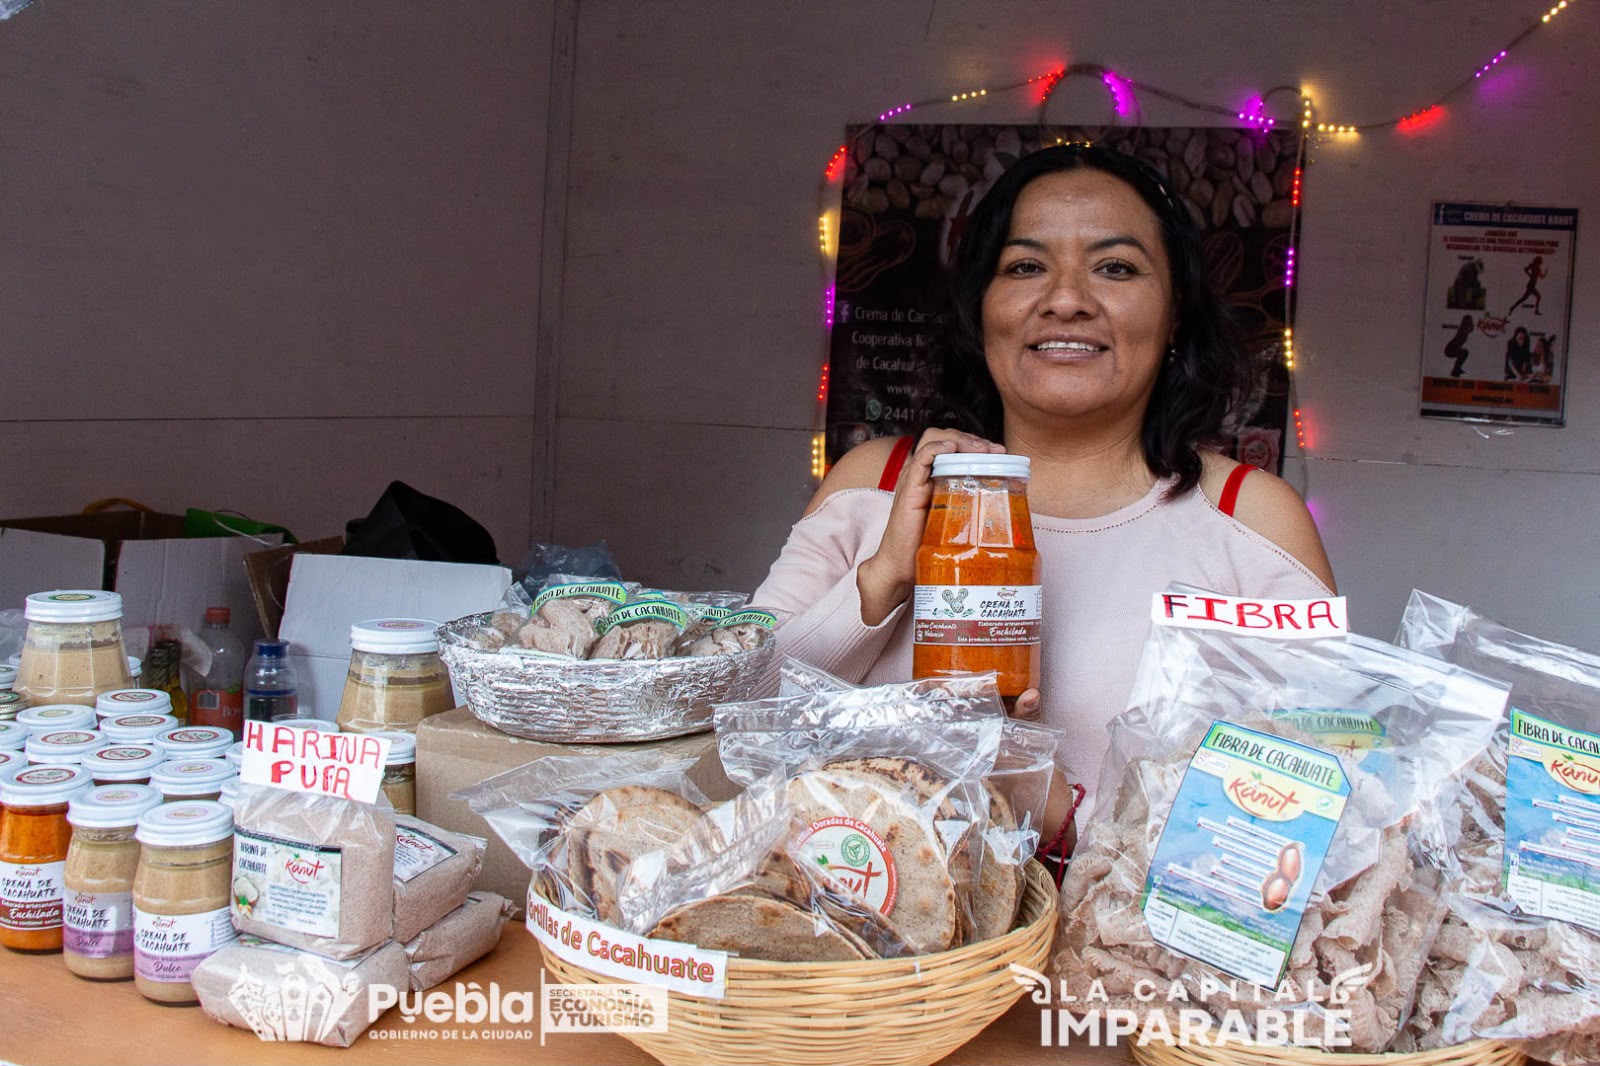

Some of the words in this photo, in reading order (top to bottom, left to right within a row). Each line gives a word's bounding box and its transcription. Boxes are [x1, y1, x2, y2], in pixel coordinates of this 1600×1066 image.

[855, 307, 888, 320] Crema
[891, 308, 904, 320] de
[852, 330, 912, 347] Cooperativa
[856, 356, 869, 369] de
[569, 585, 621, 600] CACAHUATE
[980, 600, 1010, 609] CREMA
[1013, 600, 1024, 608] DE
[1161, 594, 1339, 630] FIBRA
[621, 609, 633, 619] DE
[634, 605, 682, 623] CACAHUATE
[980, 608, 1026, 619] CACAHUATE
[1518, 719, 1549, 742] FIBRA
[1552, 730, 1566, 745] DE
[246, 721, 381, 769] HARINA
[1212, 732, 1249, 755] FIBRA
[1248, 742, 1266, 761] DE
[1266, 749, 1337, 787] CACAHUATE
[1550, 759, 1600, 788] Kanu
[813, 817, 844, 829] Doradas
[844, 818, 854, 827] de
[854, 821, 888, 853] Cacahuate
[2, 877, 31, 889] CREMA
[37, 878, 53, 888] DE
[3, 887, 57, 899] CACAHUATE
[67, 912, 110, 928] CACAHUATE
[92, 908, 106, 918] DE
[141, 928, 167, 941] CREMA
[173, 932, 187, 942] DE
[141, 939, 191, 953] CACAHUATE
[561, 920, 582, 950] de
[587, 930, 715, 983] Cacahuate
[153, 960, 181, 973] Dulce
